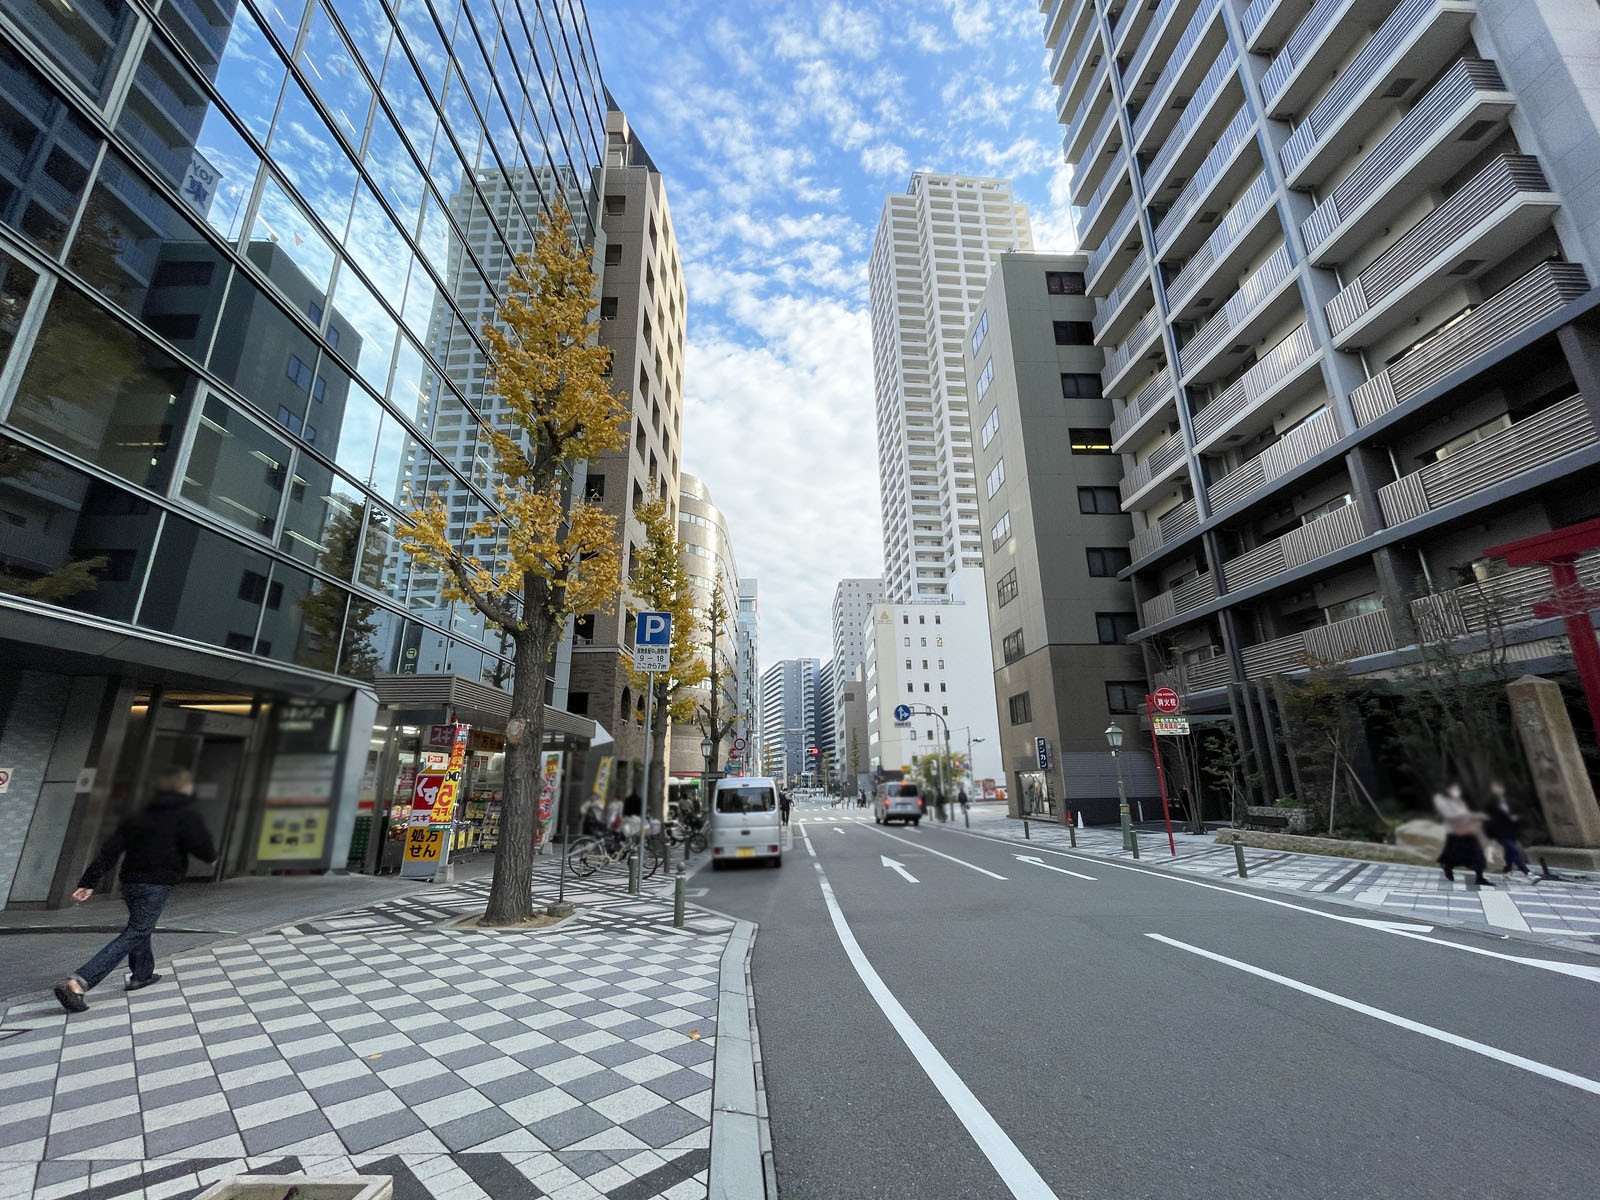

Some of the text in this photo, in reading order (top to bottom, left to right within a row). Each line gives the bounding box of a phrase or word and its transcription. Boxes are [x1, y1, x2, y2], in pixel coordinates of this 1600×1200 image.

[645, 615, 665, 642] P
[1157, 698, 1177, 707] 消火栓
[432, 727, 455, 745] スギ
[416, 777, 440, 805] くす
[411, 814, 430, 822] スギ
[411, 829, 439, 843] 処方
[409, 845, 437, 858] せん
